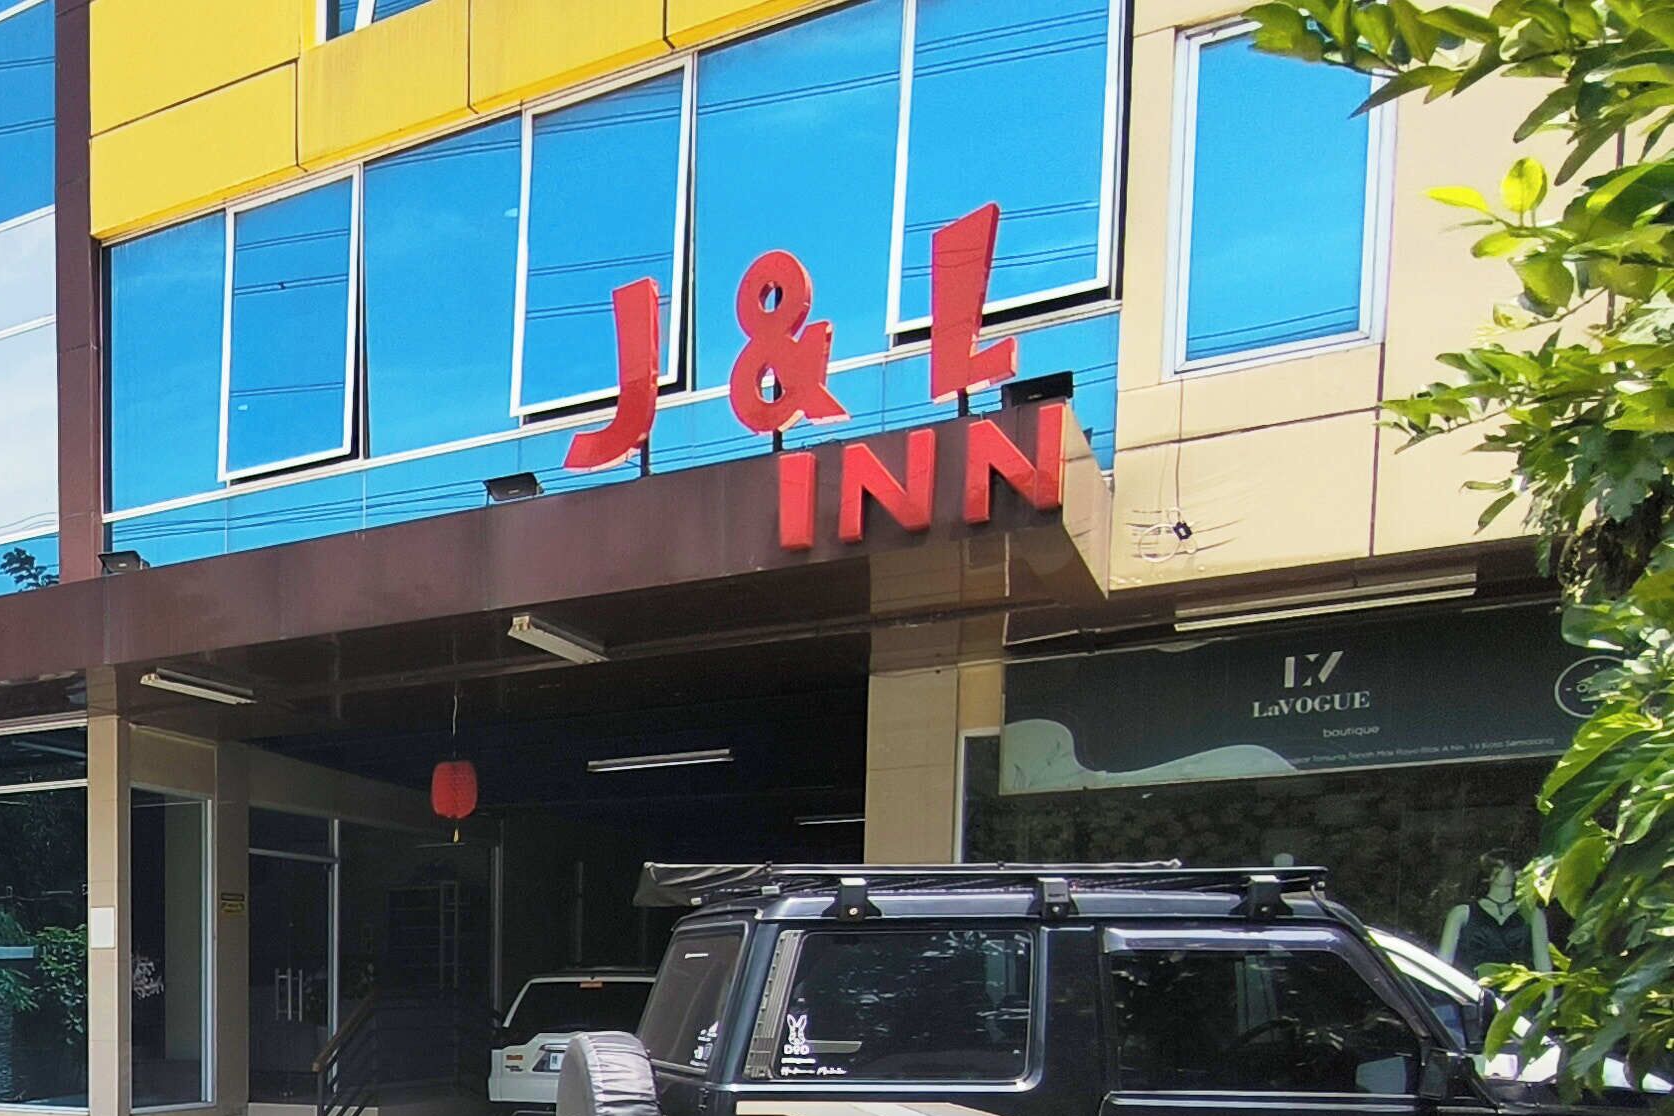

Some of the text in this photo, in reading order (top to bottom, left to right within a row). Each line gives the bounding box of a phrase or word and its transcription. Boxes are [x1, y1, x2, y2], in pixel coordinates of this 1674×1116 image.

[563, 202, 1018, 472] J & L
[779, 403, 1065, 551] INN
[1252, 690, 1371, 718] LaVOGUE
[1322, 726, 1381, 738] boutique
